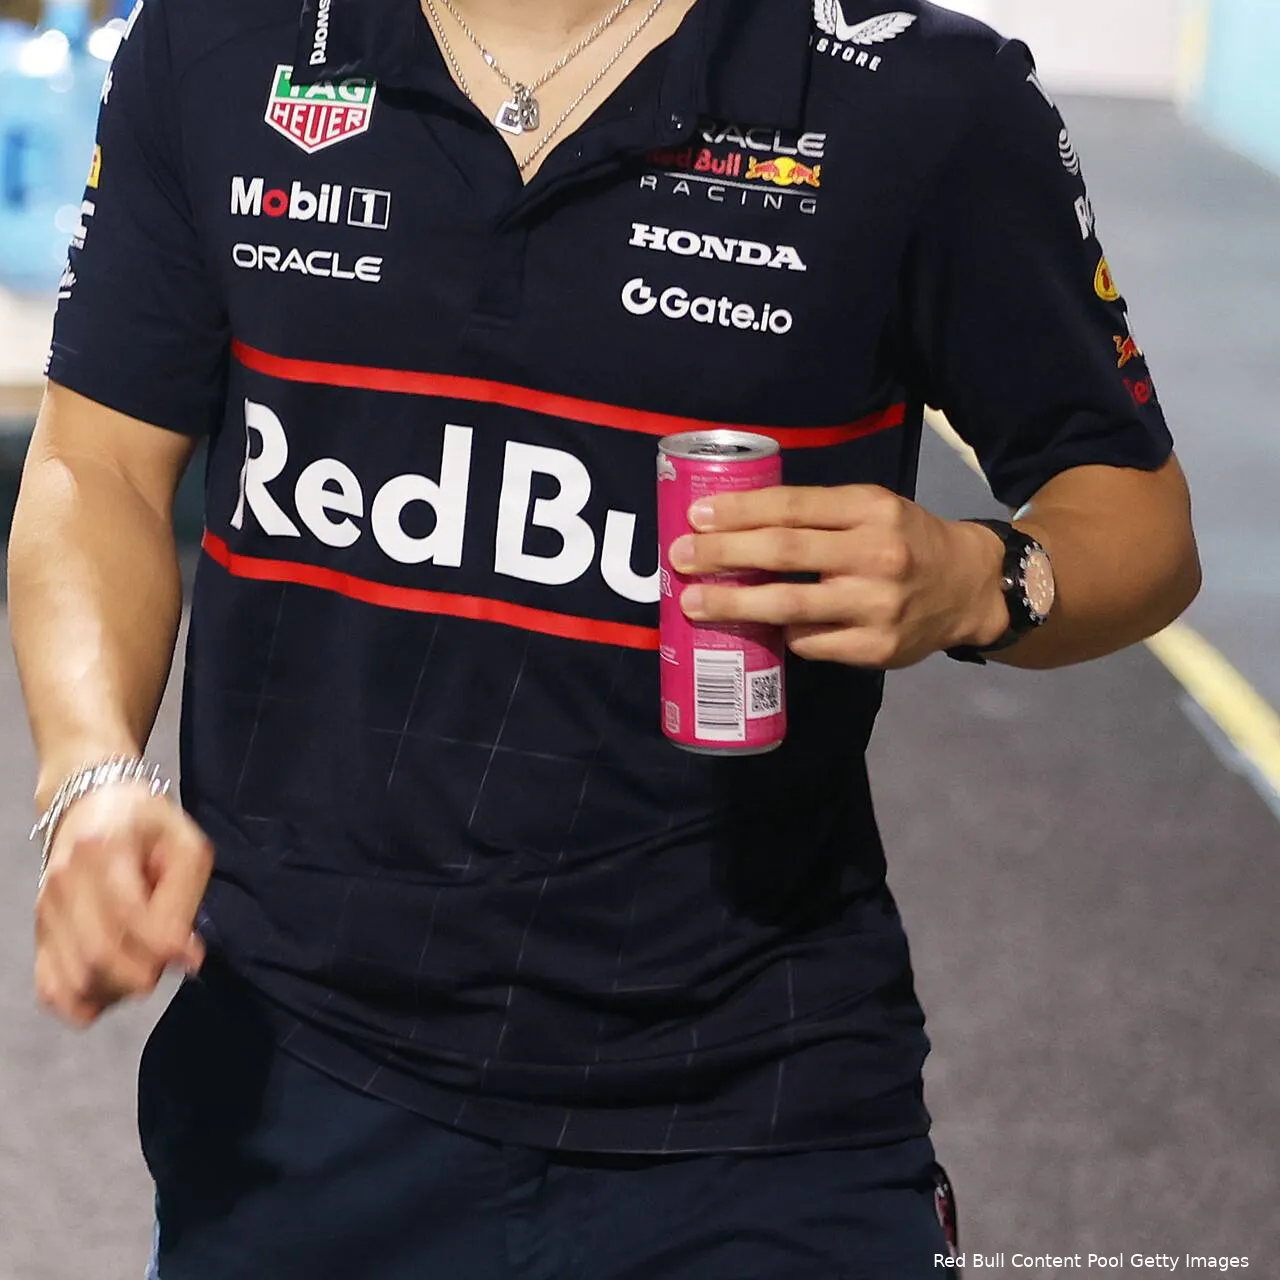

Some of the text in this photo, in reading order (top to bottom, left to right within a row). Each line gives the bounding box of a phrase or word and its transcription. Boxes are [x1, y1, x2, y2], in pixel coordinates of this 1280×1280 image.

[809, 36, 882, 71] STORE
[273, 102, 364, 146] HEUER
[701, 123, 828, 158] RACLE
[230, 176, 342, 224] Mobil
[639, 174, 817, 215] RACING
[232, 242, 384, 282] ORACLE
[628, 222, 807, 271] HONDA
[658, 285, 794, 335] Gate.io
[494, 439, 661, 604] Bu
